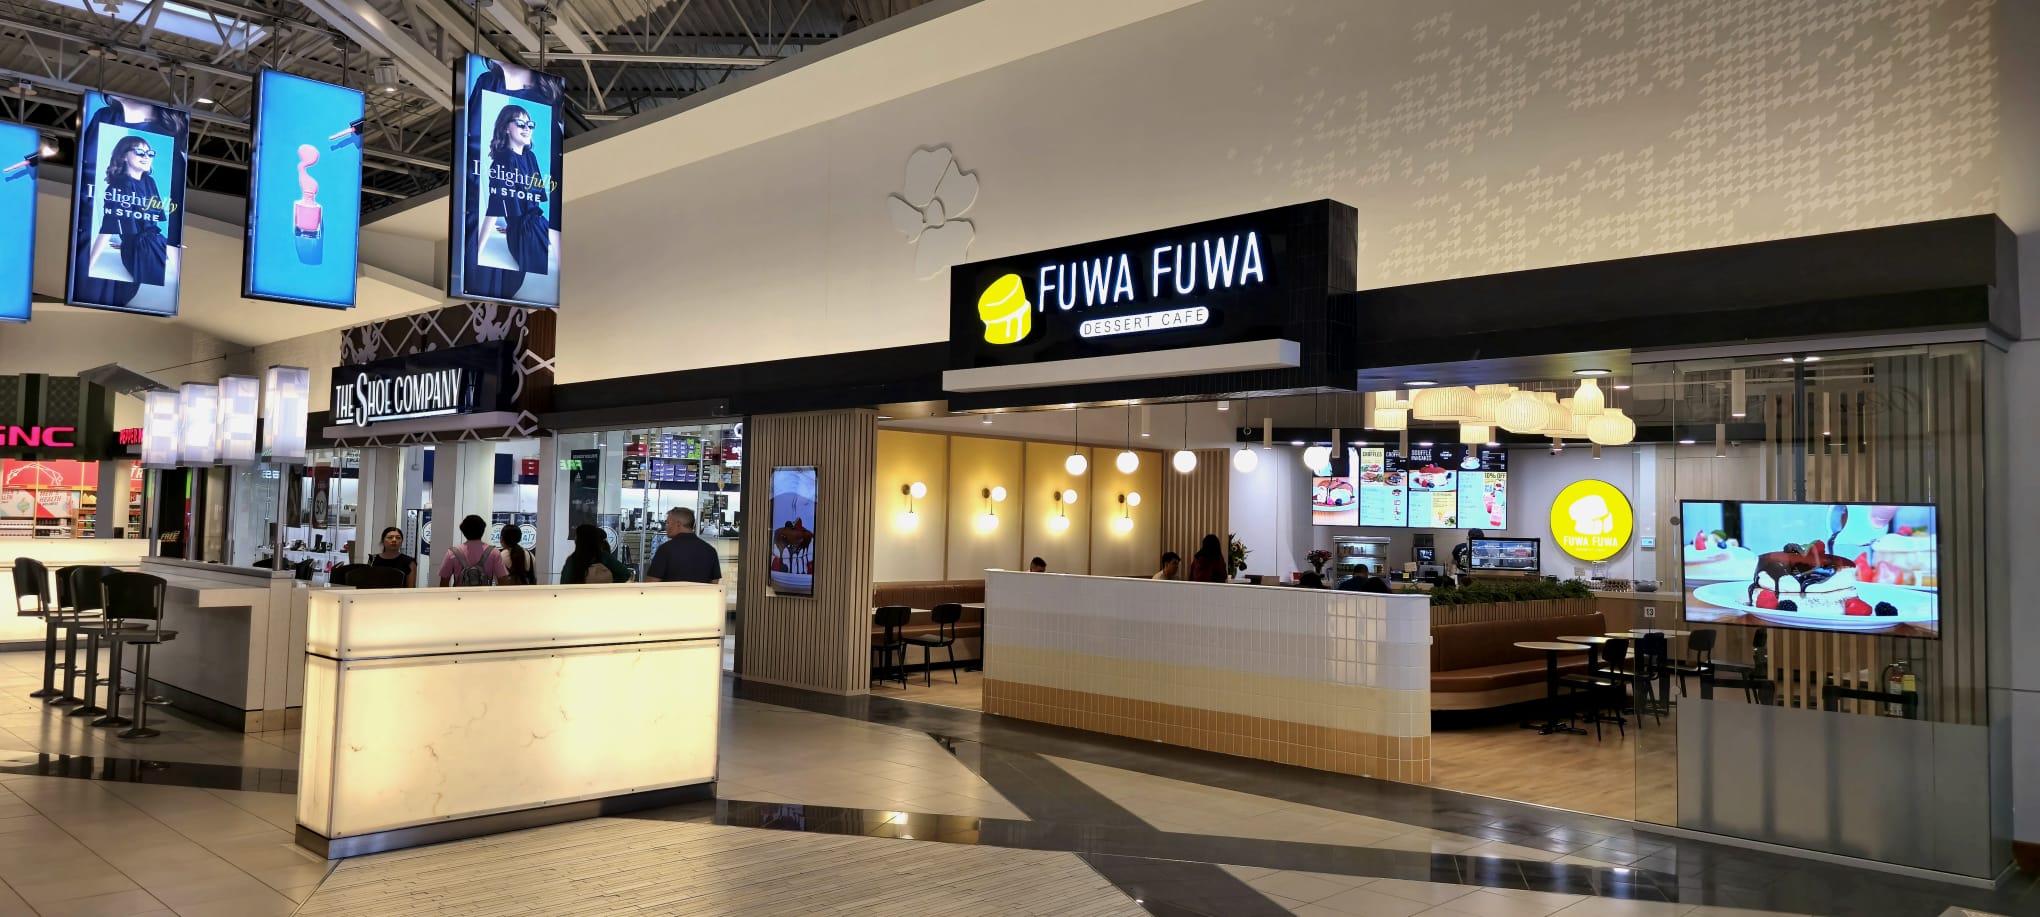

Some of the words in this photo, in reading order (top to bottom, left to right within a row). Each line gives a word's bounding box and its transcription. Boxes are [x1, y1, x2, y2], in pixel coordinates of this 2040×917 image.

[501, 187, 541, 202] STORE
[116, 208, 160, 221] STORE
[1039, 253, 1134, 313] FUWA
[1153, 231, 1264, 297] FUWA
[1084, 315, 1153, 336] DESSERT
[1161, 308, 1204, 326] CAFE
[336, 383, 354, 419] THE
[356, 372, 393, 428] SHOE
[394, 368, 462, 413] COMPANY
[0, 425, 75, 447] NC
[1563, 535, 1589, 546] FUWA
[1591, 536, 1619, 548] FUWA
